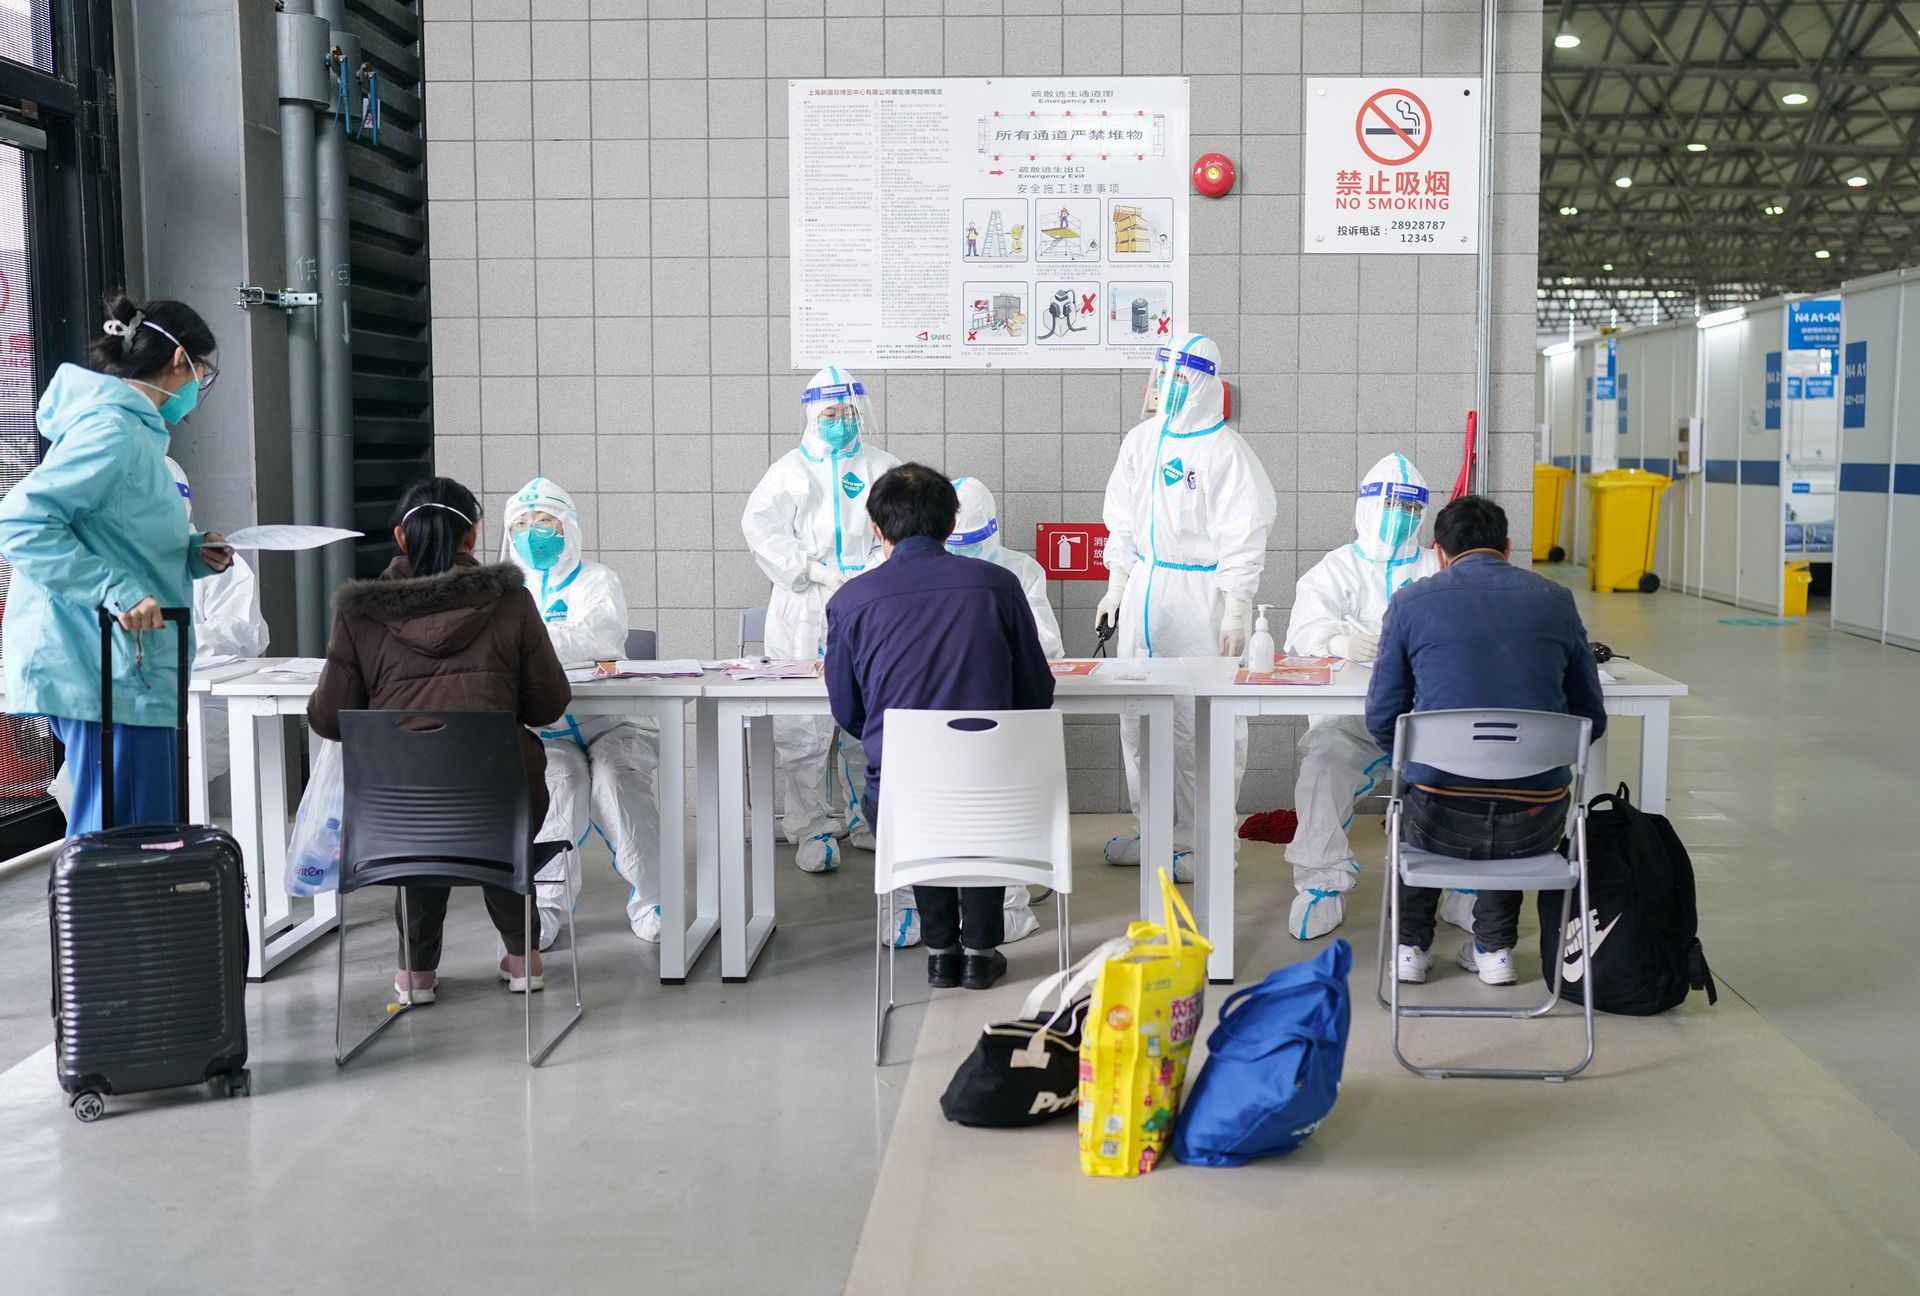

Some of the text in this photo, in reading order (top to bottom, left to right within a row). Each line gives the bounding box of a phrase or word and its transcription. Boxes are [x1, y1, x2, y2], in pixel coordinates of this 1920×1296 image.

[995, 129, 1144, 141] 所有通道严禁堆物
[1017, 183, 1120, 194] 安全施工注意事项
[1336, 170, 1450, 197] 禁止吸烟
[1336, 198, 1450, 210] NO SMOKING
[1391, 220, 1446, 230] 28928787
[1400, 234, 1434, 243] 12345
[1795, 313, 1809, 323] N4
[1846, 364, 1856, 379] N4
[1094, 550, 1104, 559] 放
